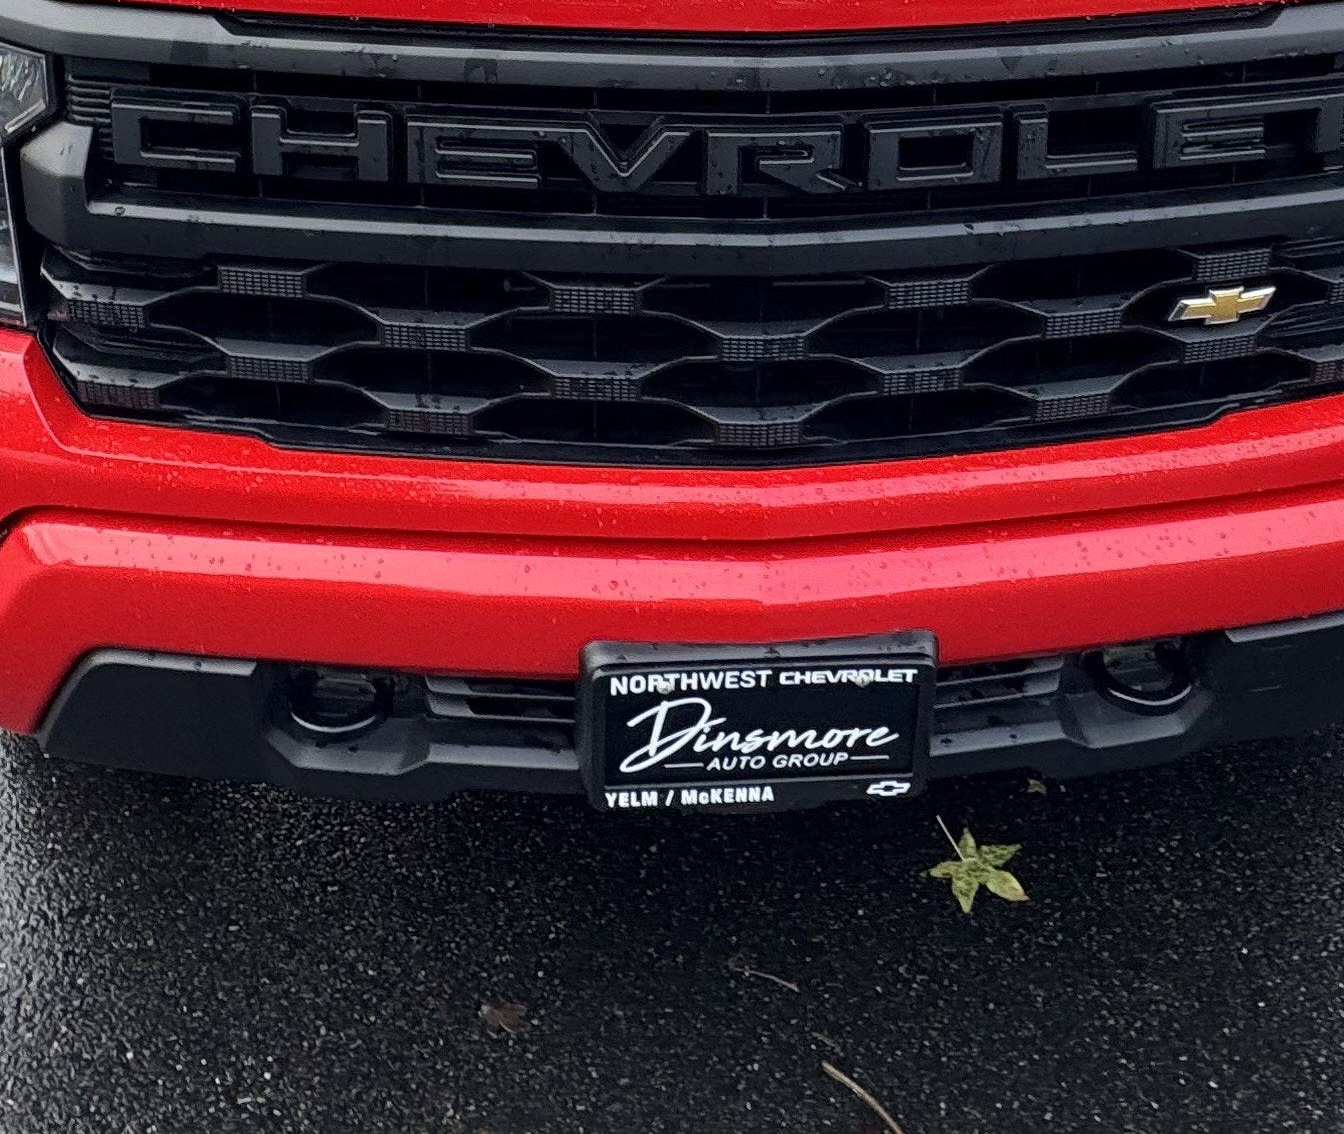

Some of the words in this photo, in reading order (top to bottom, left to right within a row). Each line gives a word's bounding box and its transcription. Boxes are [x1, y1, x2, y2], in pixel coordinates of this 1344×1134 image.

[610, 669, 773, 696] NORTHWEST
[778, 668, 919, 685] CHEVROLET
[619, 697, 900, 773] Dinsmore
[705, 756, 766, 772] AUTO
[771, 751, 850, 769] GROUP
[604, 790, 659, 808] YELM
[680, 786, 775, 805] McKENNA
